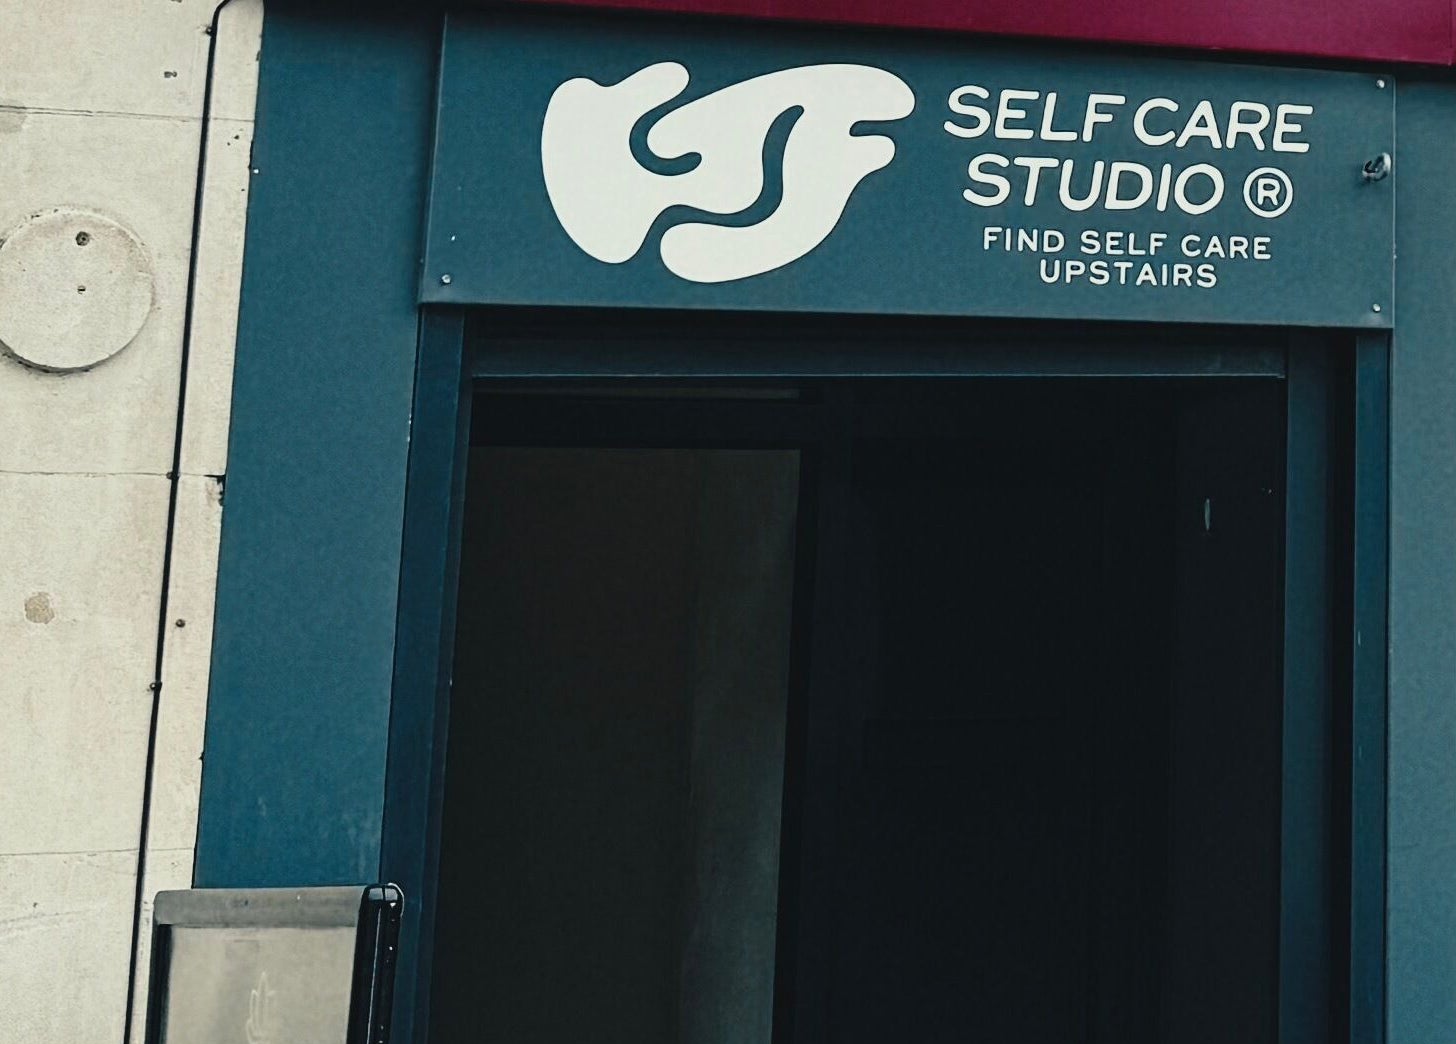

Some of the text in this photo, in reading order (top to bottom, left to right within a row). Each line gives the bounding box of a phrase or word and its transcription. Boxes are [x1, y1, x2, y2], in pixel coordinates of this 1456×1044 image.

[944, 86, 1314, 153] SELF CARE
[963, 154, 1225, 215] STUDIO
[983, 227, 1271, 260] FIND SELF CARE
[1040, 258, 1217, 288] UPSTAIRS
